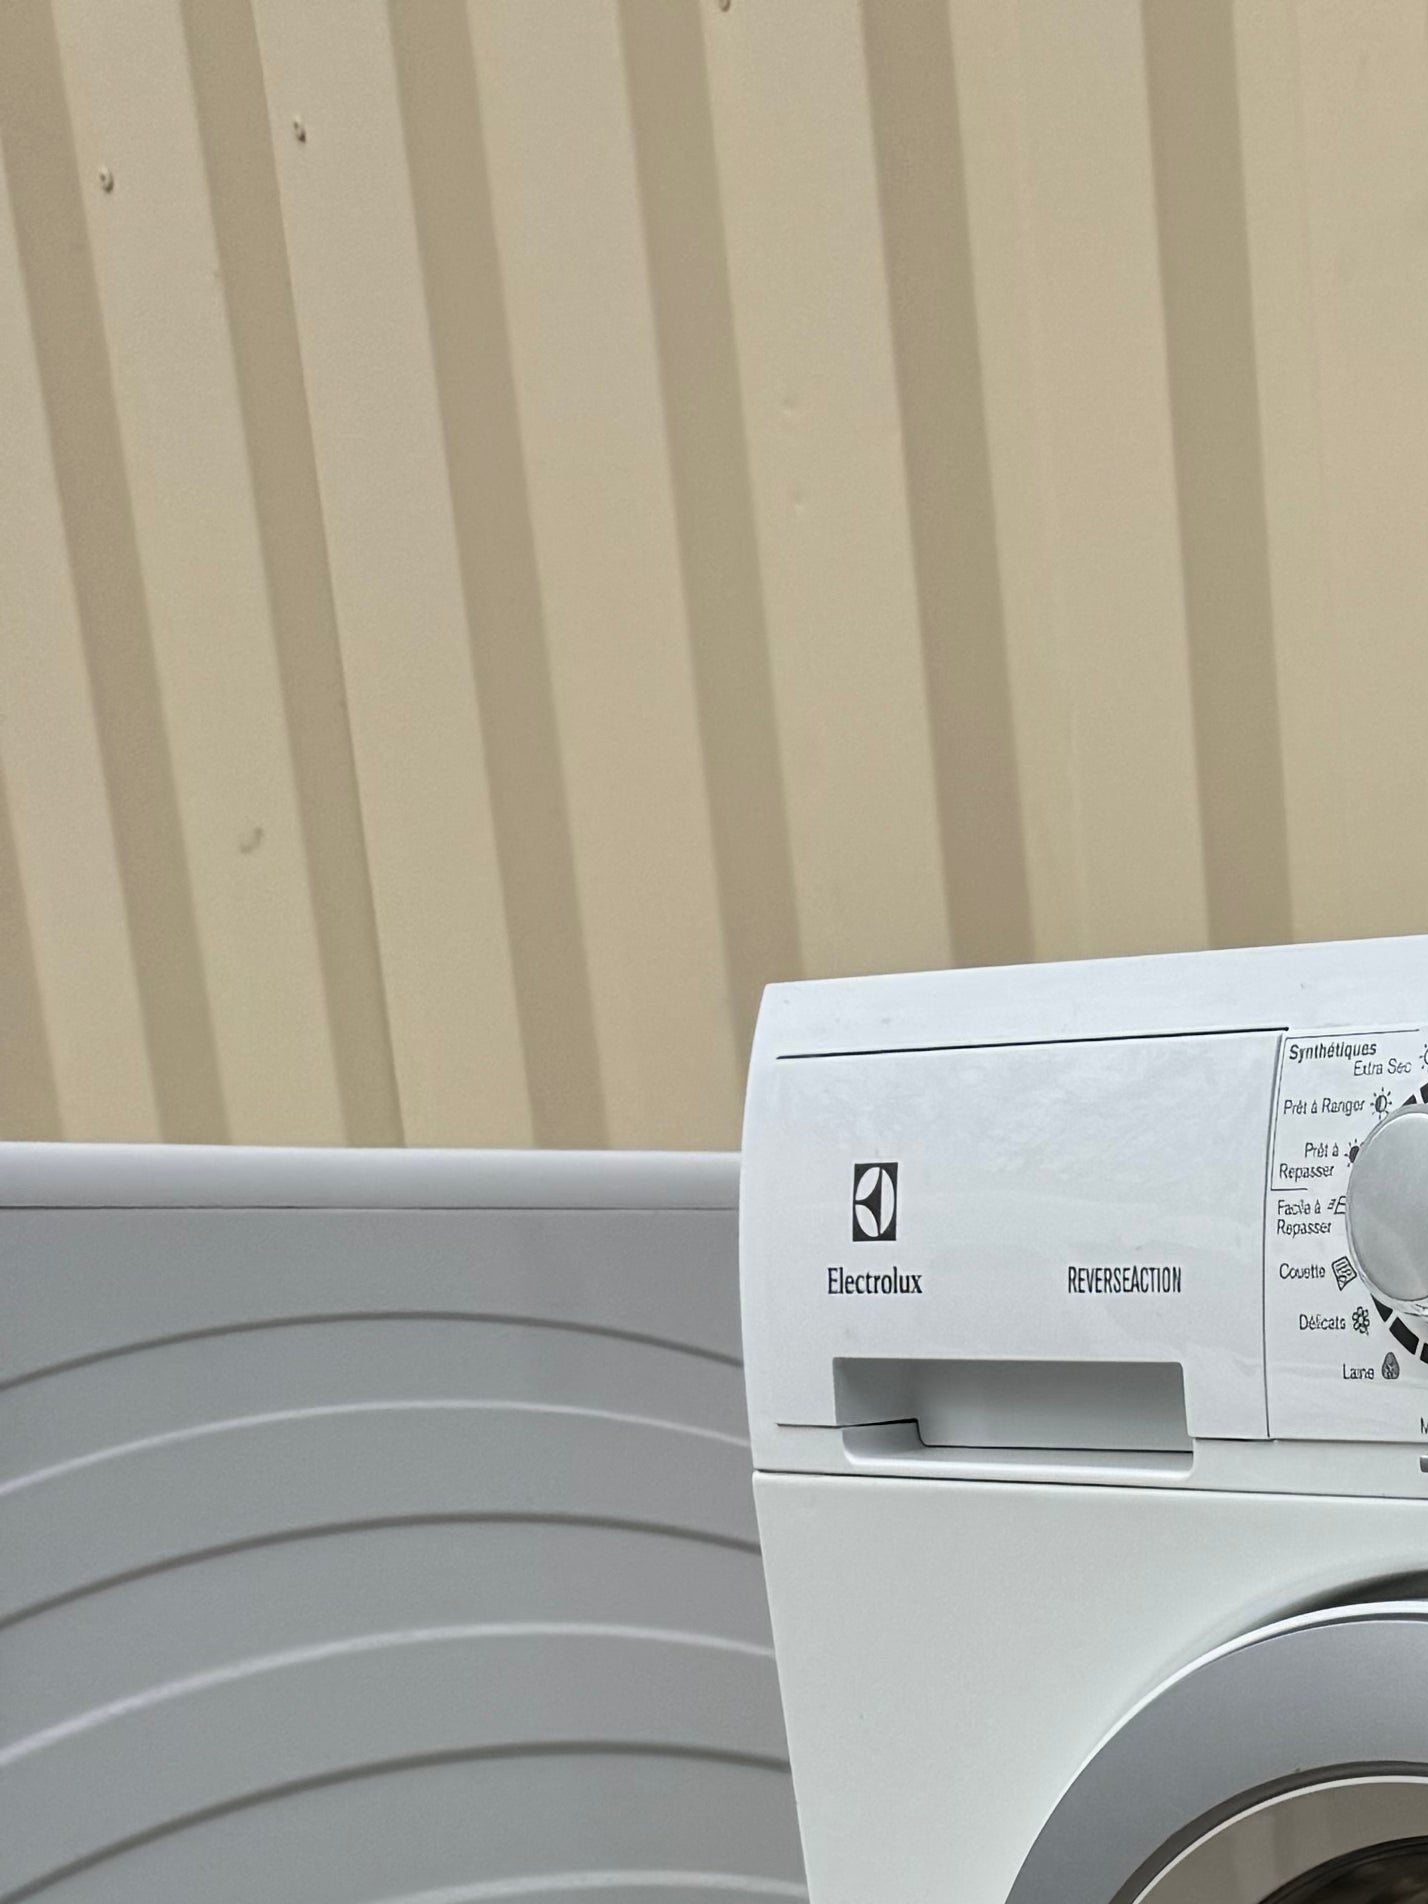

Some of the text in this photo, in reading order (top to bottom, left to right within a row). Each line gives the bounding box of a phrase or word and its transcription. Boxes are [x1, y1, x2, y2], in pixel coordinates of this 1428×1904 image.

[1288, 1041, 1378, 1064] Synthétiques
[1387, 1057, 1412, 1074] Sec
[1279, 1162, 1335, 1183] Repasser
[1276, 1219, 1333, 1239] Repasser
[827, 1266, 923, 1296] Electrolux
[1067, 1265, 1182, 1295] REVERSEACTION
[1278, 1262, 1326, 1280] Couette
